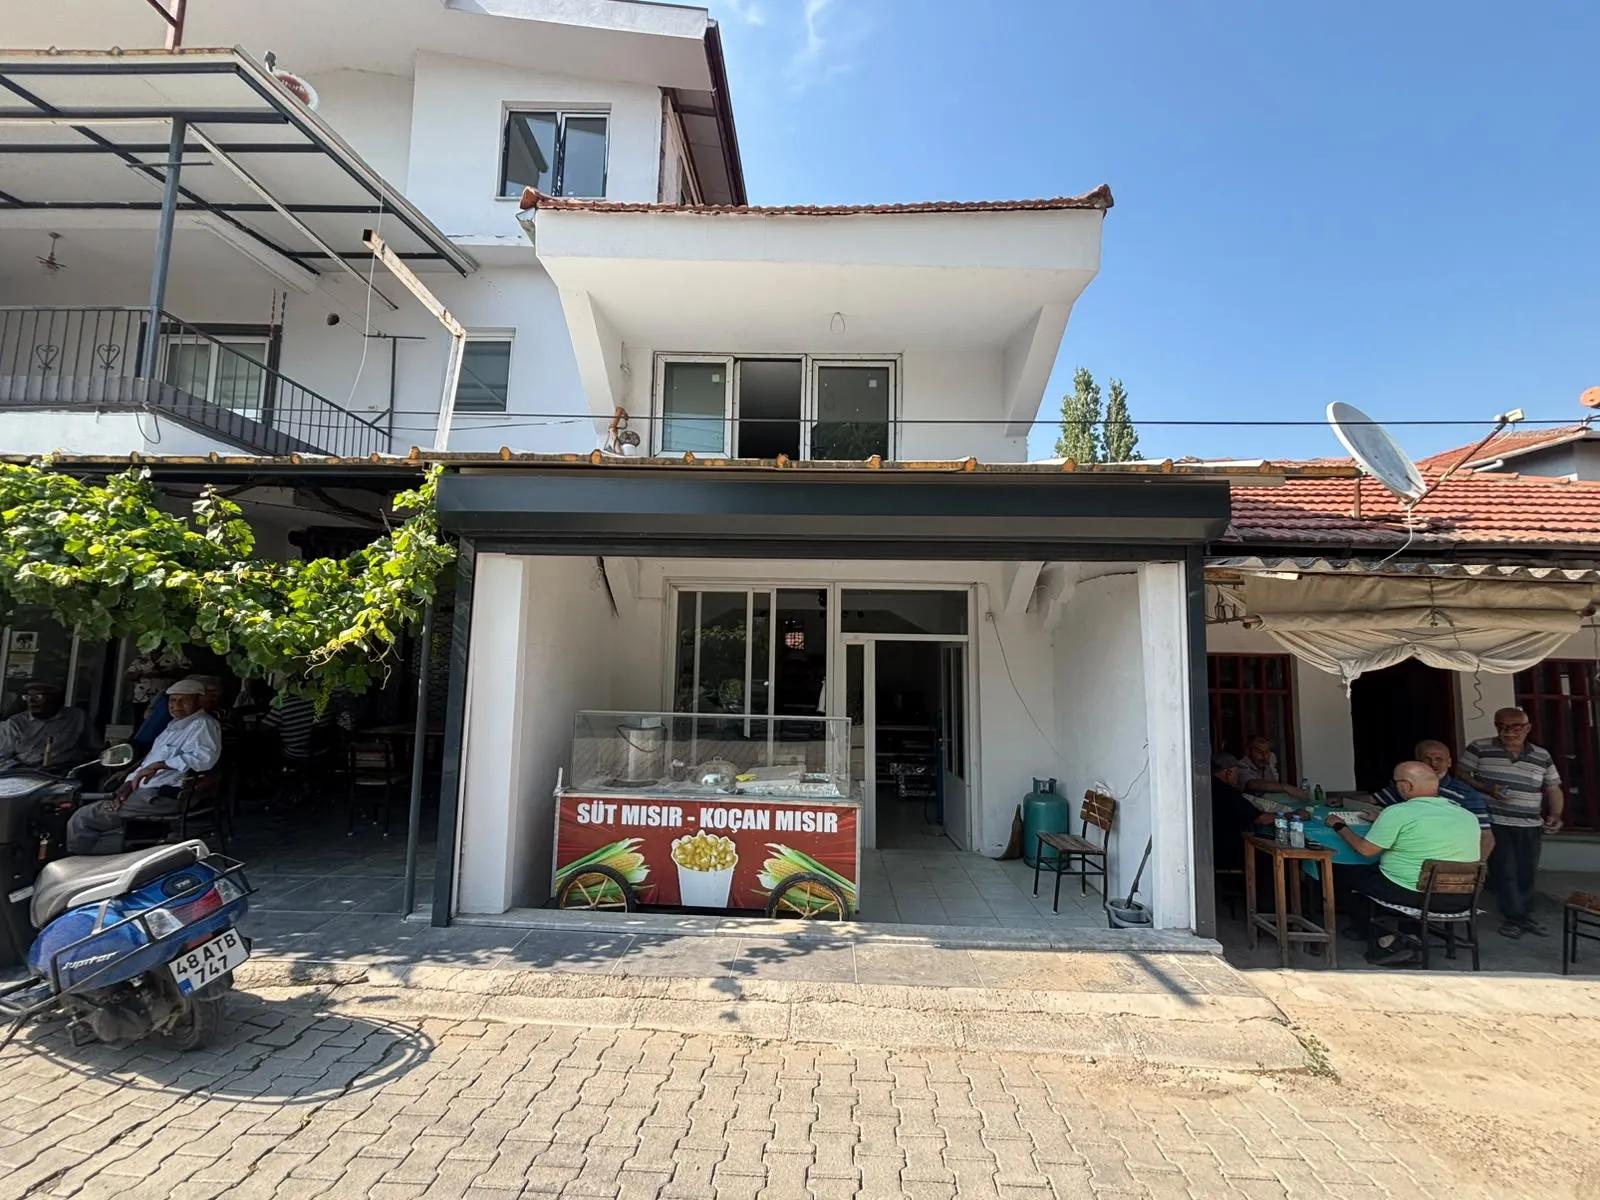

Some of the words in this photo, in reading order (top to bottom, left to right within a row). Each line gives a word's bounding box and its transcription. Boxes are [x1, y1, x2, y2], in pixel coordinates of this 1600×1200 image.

[577, 800, 617, 825] SÜT
[621, 804, 683, 827] MISIR
[700, 807, 770, 833] KOÇAN
[775, 810, 838, 833] MISIR
[176, 954, 199, 975] 48
[203, 933, 237, 962] ATB
[194, 955, 228, 984] 747
